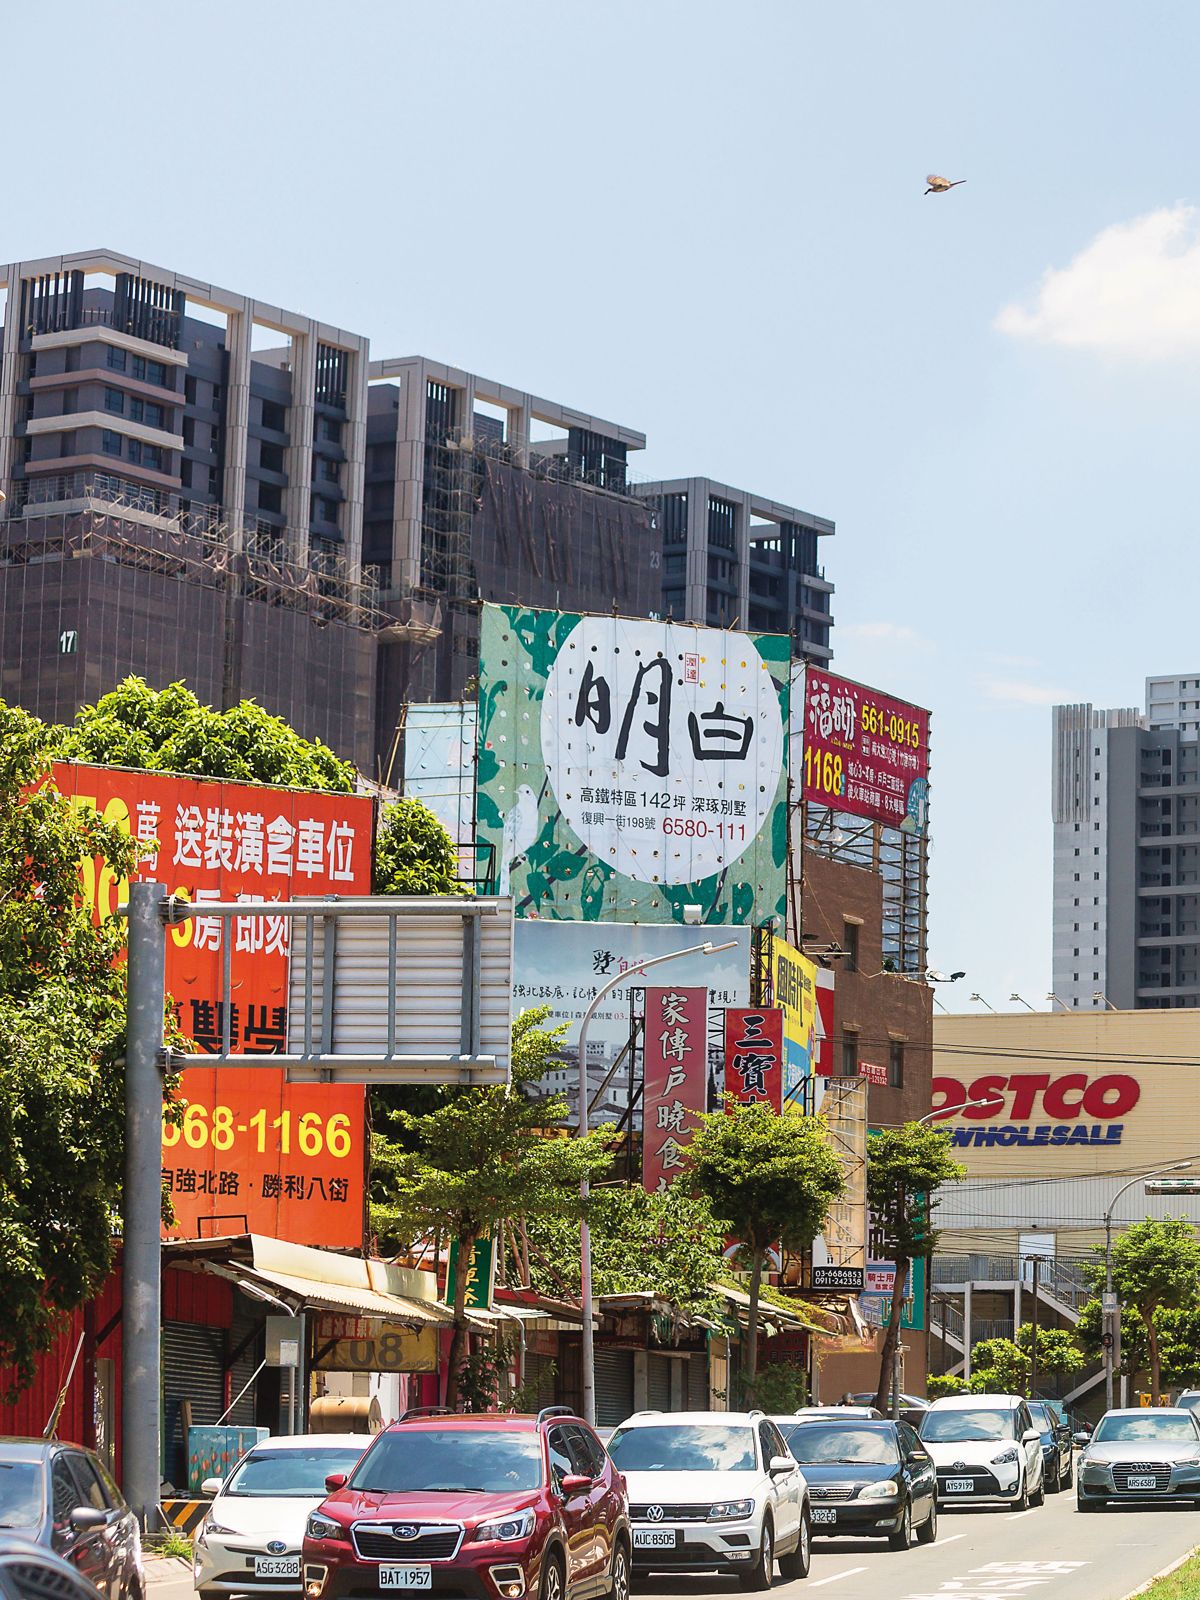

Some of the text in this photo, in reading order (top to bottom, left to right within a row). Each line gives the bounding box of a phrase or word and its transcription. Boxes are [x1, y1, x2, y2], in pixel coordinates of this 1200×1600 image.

[574, 655, 754, 778] 明白
[862, 704, 920, 748] 561-0915
[804, 746, 842, 796] 1168
[580, 787, 686, 811] 高鐵特區142坪
[581, 811, 747, 841] 復興一街198號 6580-111
[173, 803, 355, 882] 送裝潢含車位
[952, 1125, 1124, 1148] WHOLESALE
[815, 1270, 862, 1279] 03-6686853
[815, 1277, 862, 1286] 0911-242358
[634, 1532, 675, 1546] AUC-8305
[256, 1561, 299, 1576] ASG-3288
[380, 1571, 431, 1587] BAT-1957
